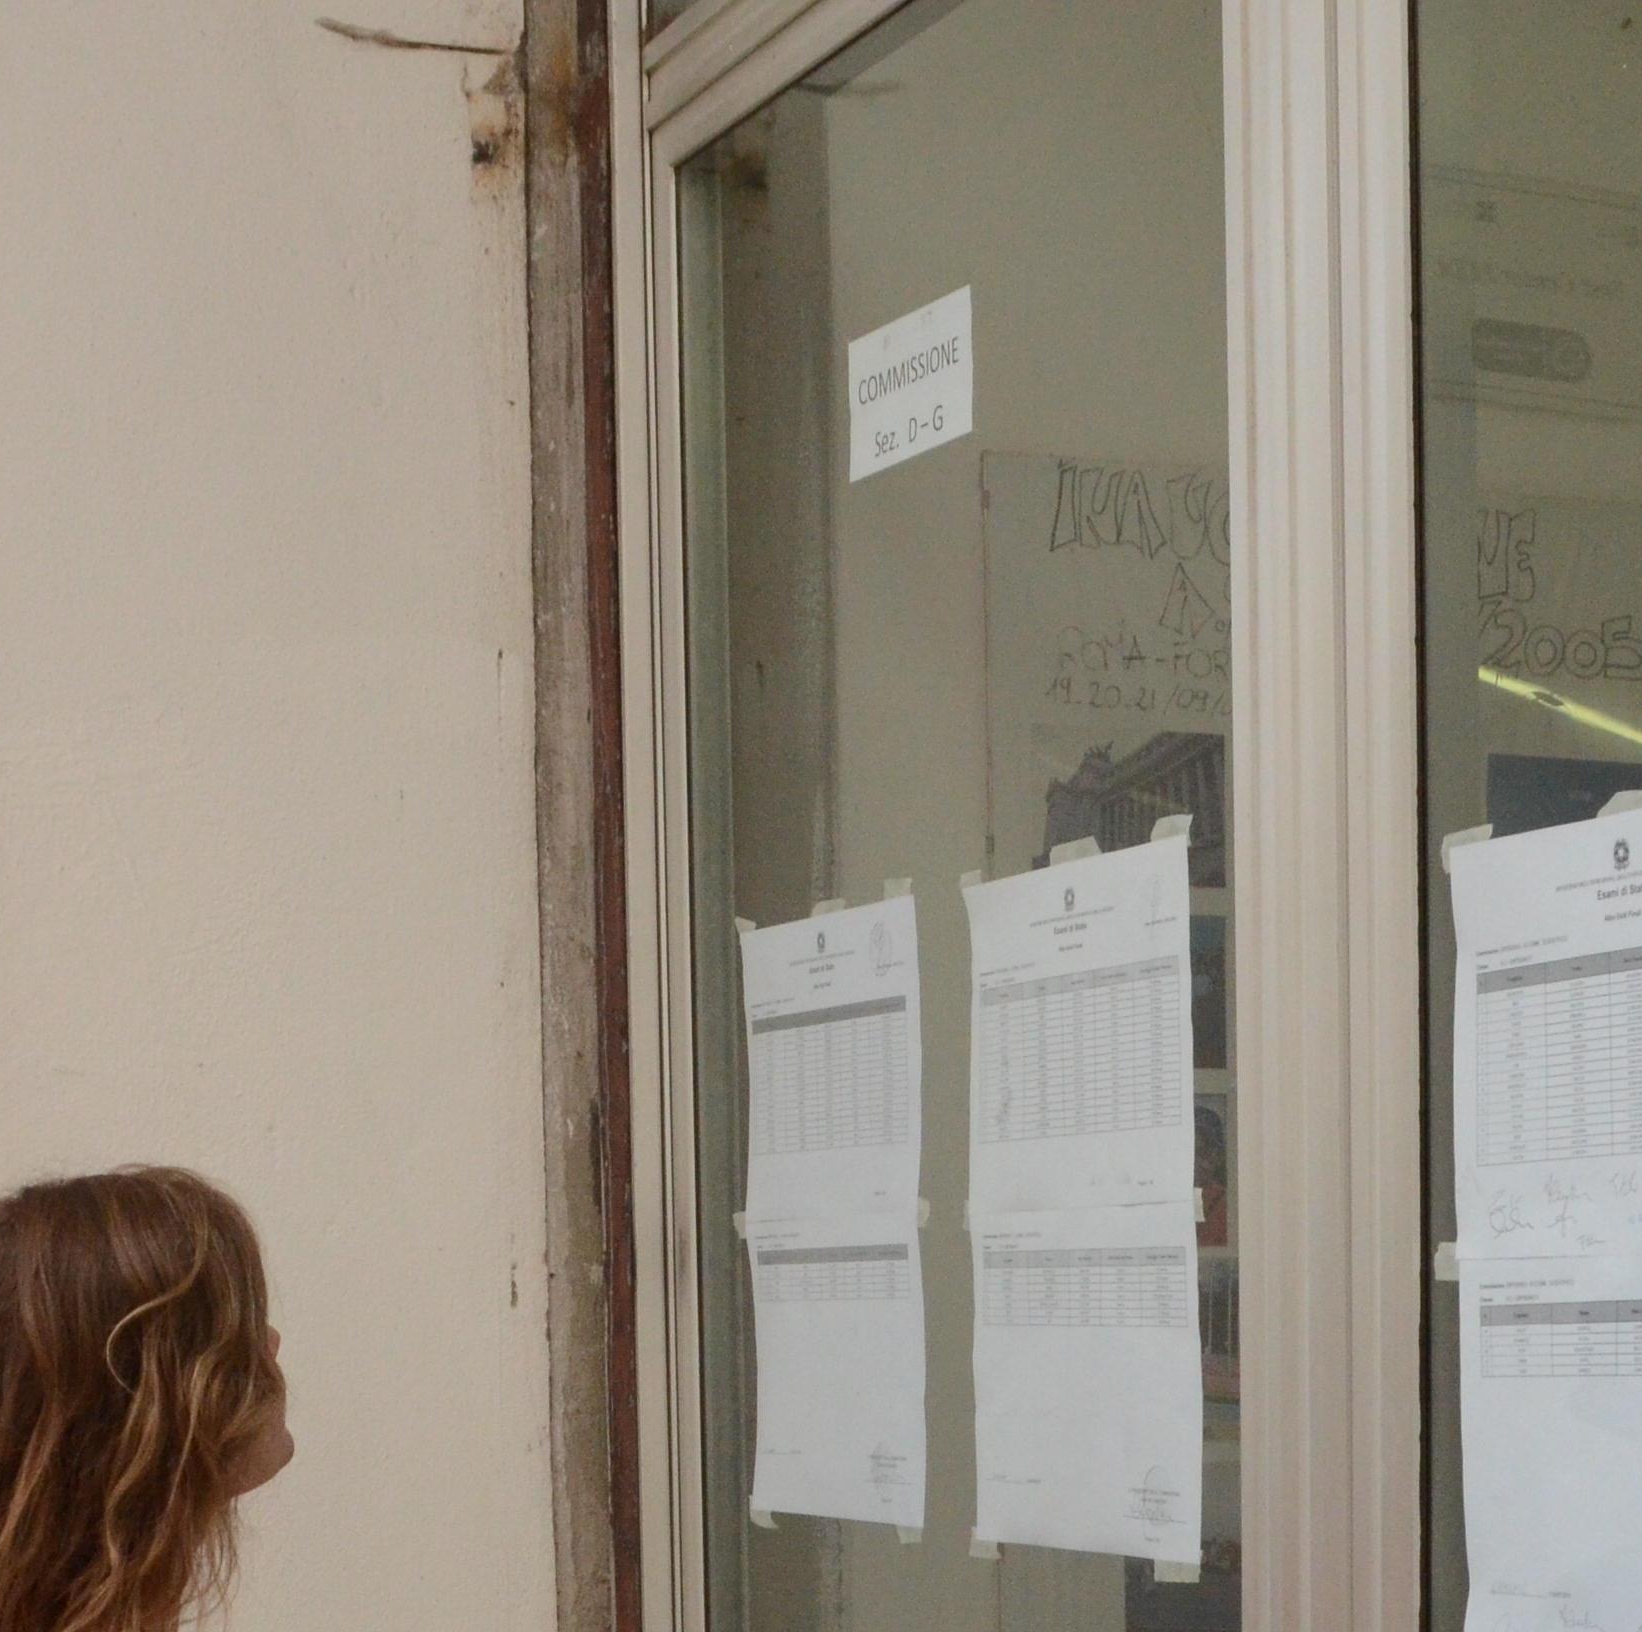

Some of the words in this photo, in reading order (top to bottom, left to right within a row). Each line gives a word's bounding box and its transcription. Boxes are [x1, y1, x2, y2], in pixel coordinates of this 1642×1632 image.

[858, 336, 960, 405] COMMISSIONE
[874, 430, 900, 458] Sez.
[908, 417, 917, 443] D
[932, 404, 944, 431] G
